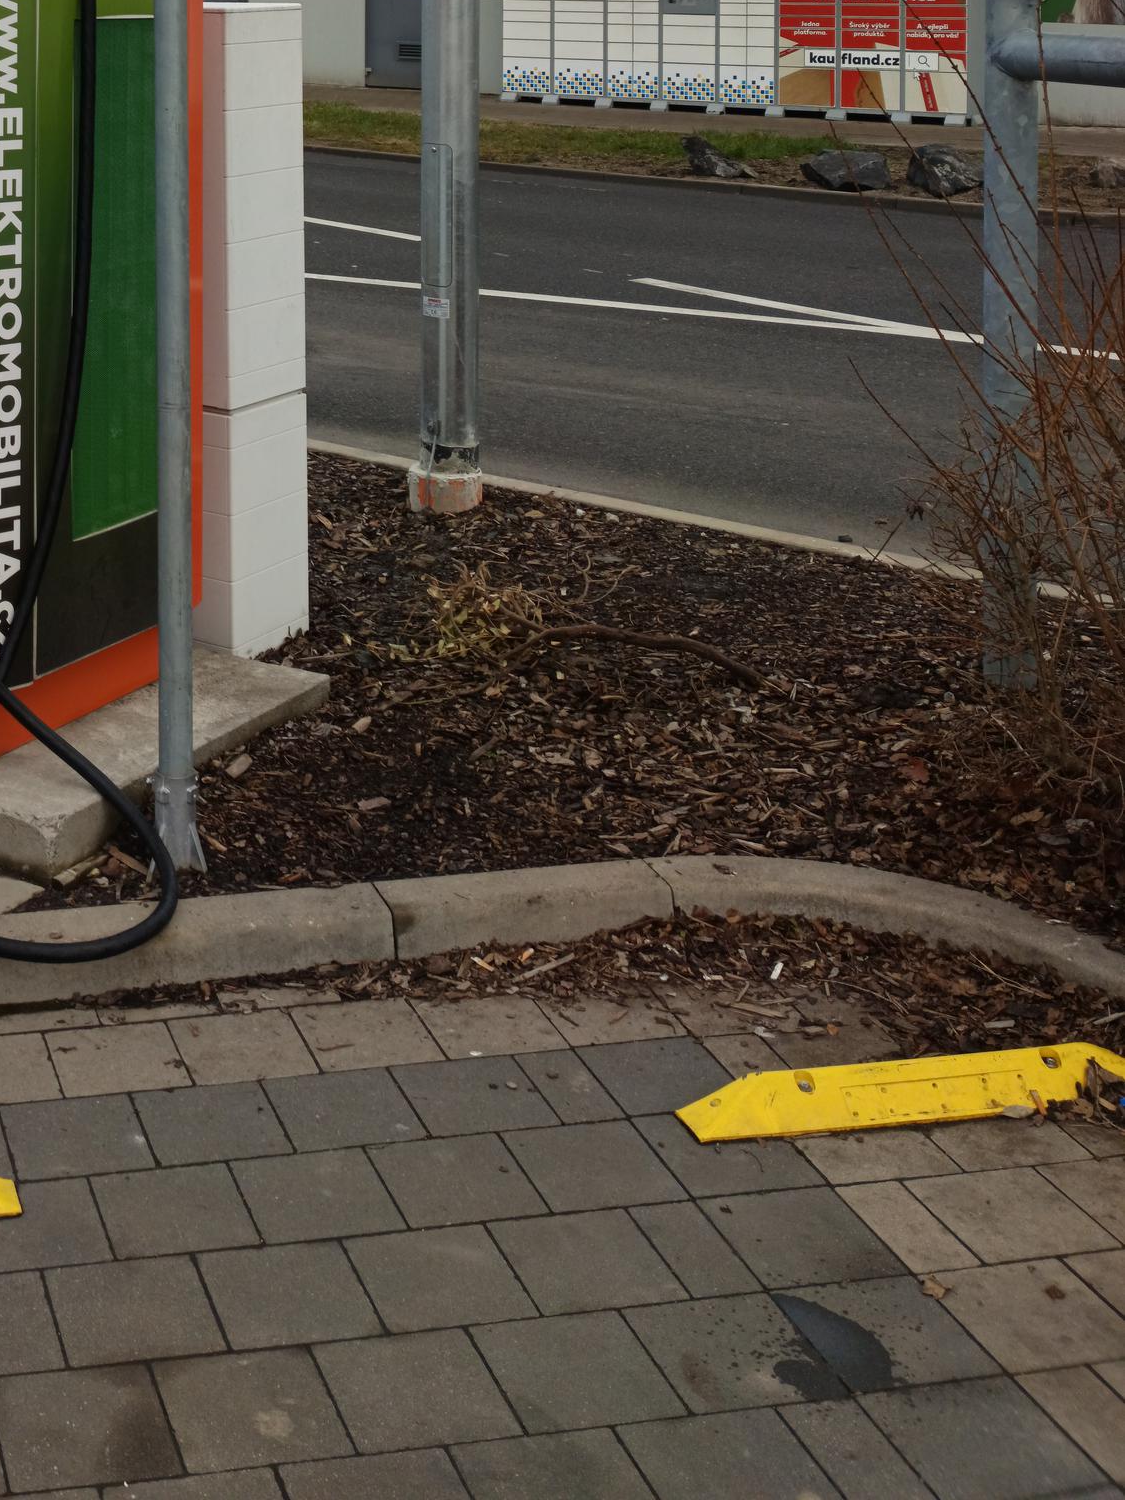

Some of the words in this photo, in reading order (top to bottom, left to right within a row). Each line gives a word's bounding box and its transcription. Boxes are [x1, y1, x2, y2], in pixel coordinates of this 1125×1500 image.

[849, 21, 870, 30] Široký
[871, 22, 890, 30] výběr
[923, 23, 949, 31] ejlepší
[793, 29, 828, 37] platforma.
[809, 52, 900, 67] kaufland.cz
